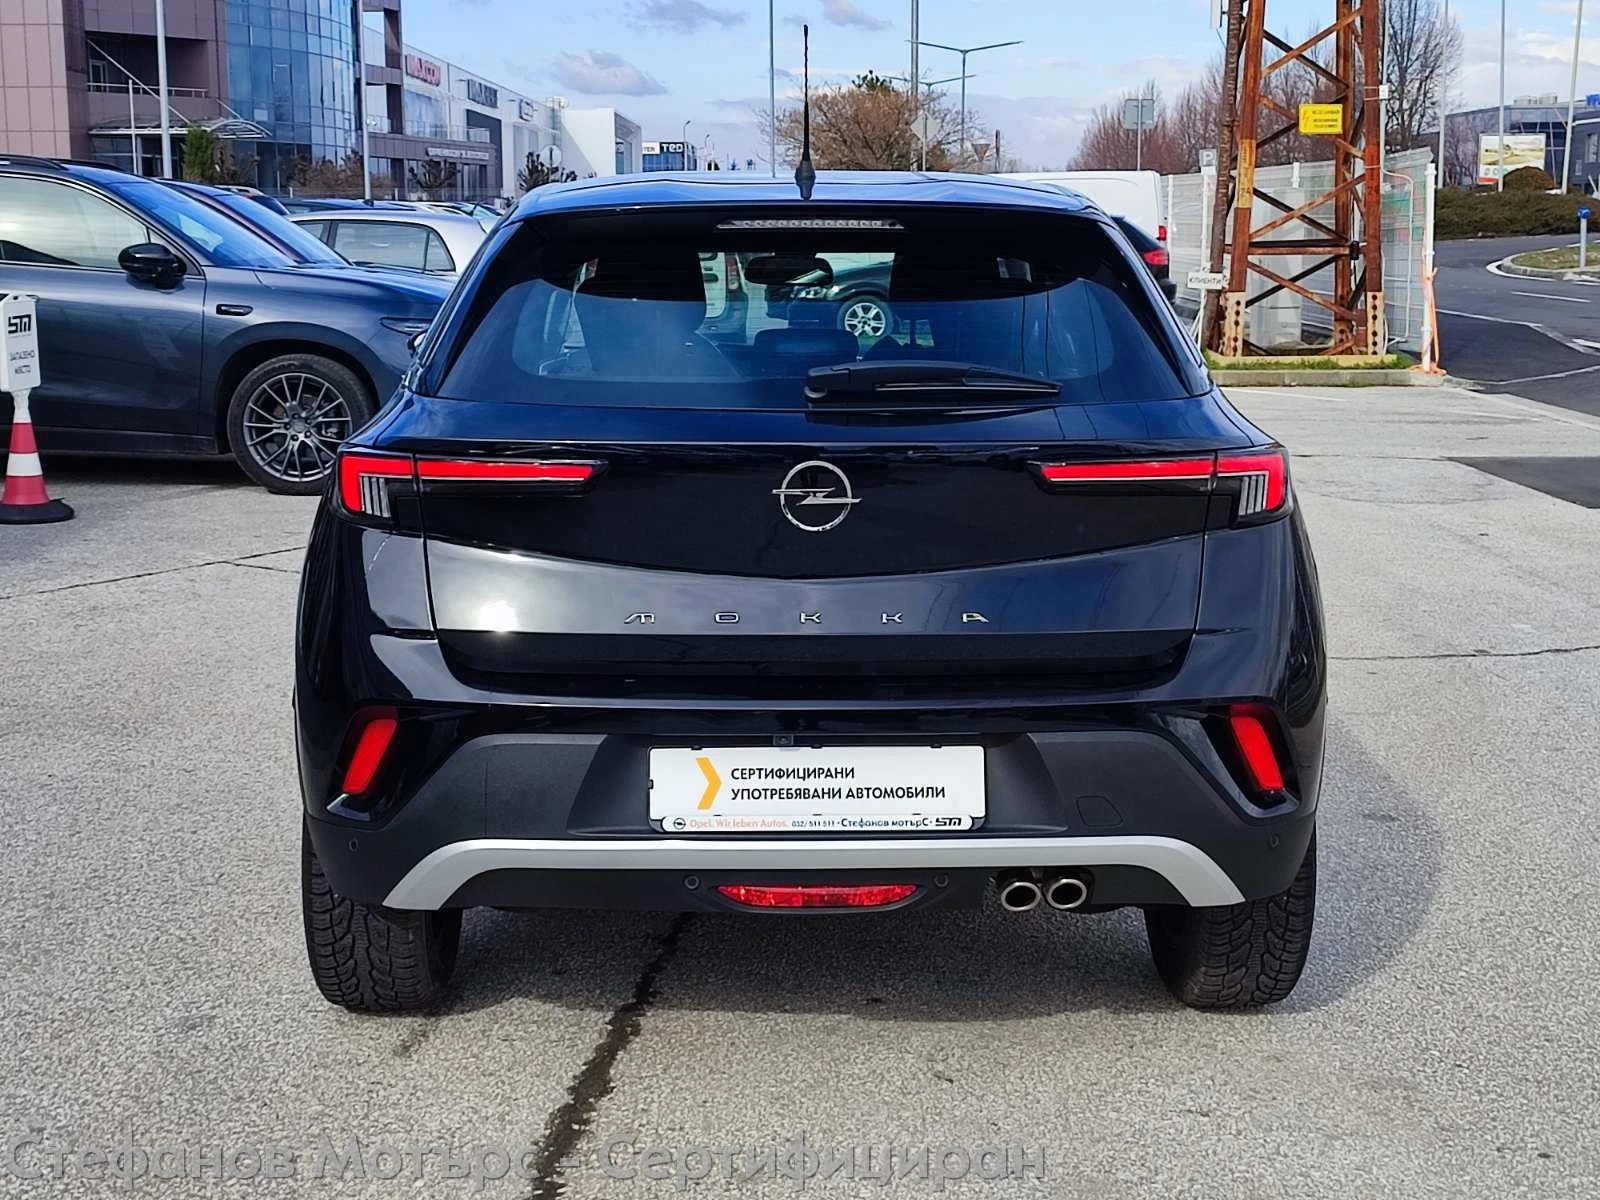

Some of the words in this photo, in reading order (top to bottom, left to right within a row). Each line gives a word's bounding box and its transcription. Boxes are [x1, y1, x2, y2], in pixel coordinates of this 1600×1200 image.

[1203, 151, 1214, 165] P
[624, 611, 990, 625] MOKKA
[731, 766, 855, 783] СЕРТИФИЦИРАНИ
[731, 786, 842, 801] УПОТРЕБЯВАНИ
[845, 785, 946, 800] АВТОМОБИЛИ
[841, 817, 889, 829] Стефанов
